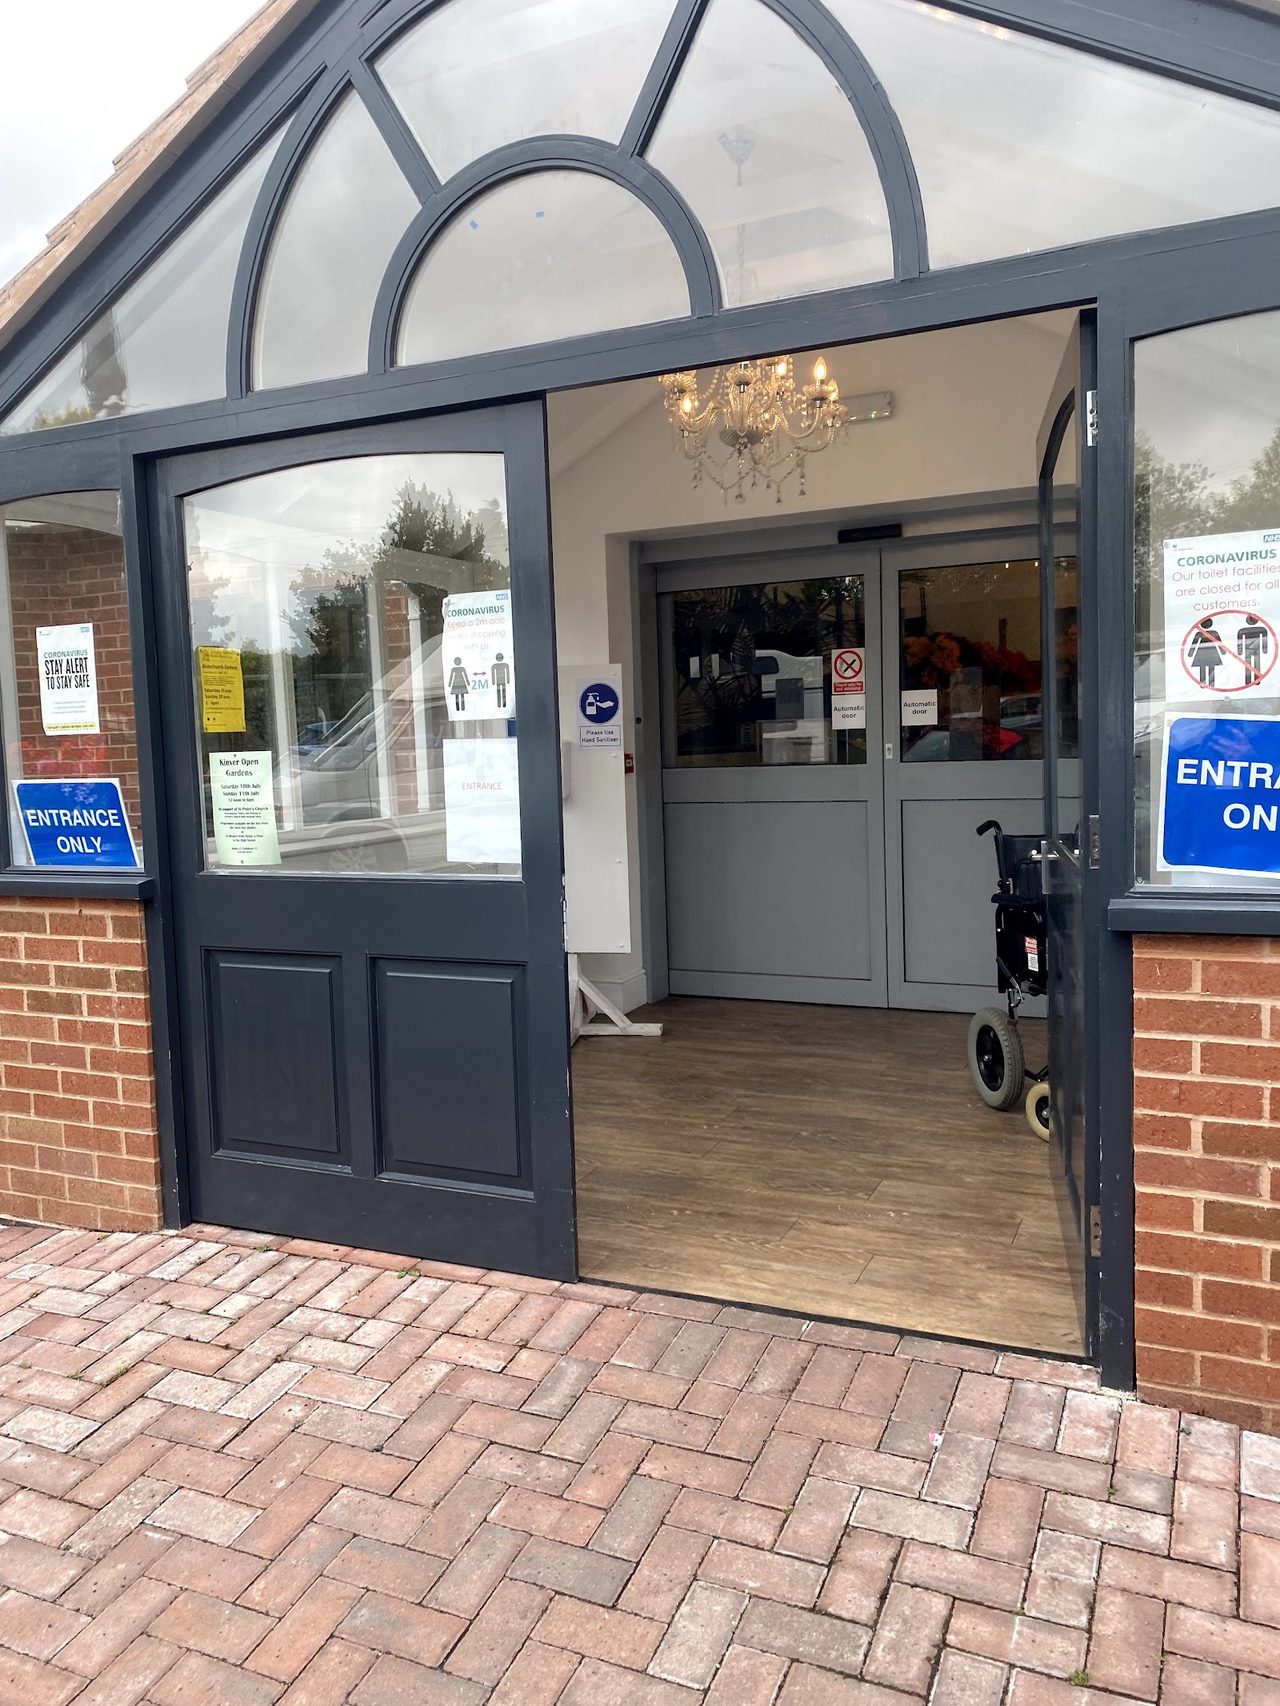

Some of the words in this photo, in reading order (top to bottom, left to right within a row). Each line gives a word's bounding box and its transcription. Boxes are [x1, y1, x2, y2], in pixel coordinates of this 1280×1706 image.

[1177, 549, 1277, 567] CORONAVIRUS
[1172, 571, 1194, 582] Our
[1198, 567, 1228, 580] toilet
[1175, 587, 1196, 597] are
[1199, 582, 1241, 595] closed
[1244, 580, 1262, 591] for
[1264, 578, 1280, 589] all
[447, 605, 505, 618] CORONAVIRUS
[44, 649, 88, 659] CORONAVIRUS
[44, 658, 64, 676] STAY
[65, 657, 88, 674] ALERT
[46, 676, 55, 690] TO
[56, 675, 73, 690] STAY
[74, 674, 90, 689] SAFE
[471, 679, 489, 691] 2M
[903, 700, 936, 708] Automatic
[219, 758, 240, 766] Kinver
[241, 758, 259, 766] Open
[225, 769, 253, 777] Gardens
[462, 782, 502, 791] ENTRANCE
[26, 808, 122, 827] ENTRANCE
[56, 835, 103, 854] ONLY
